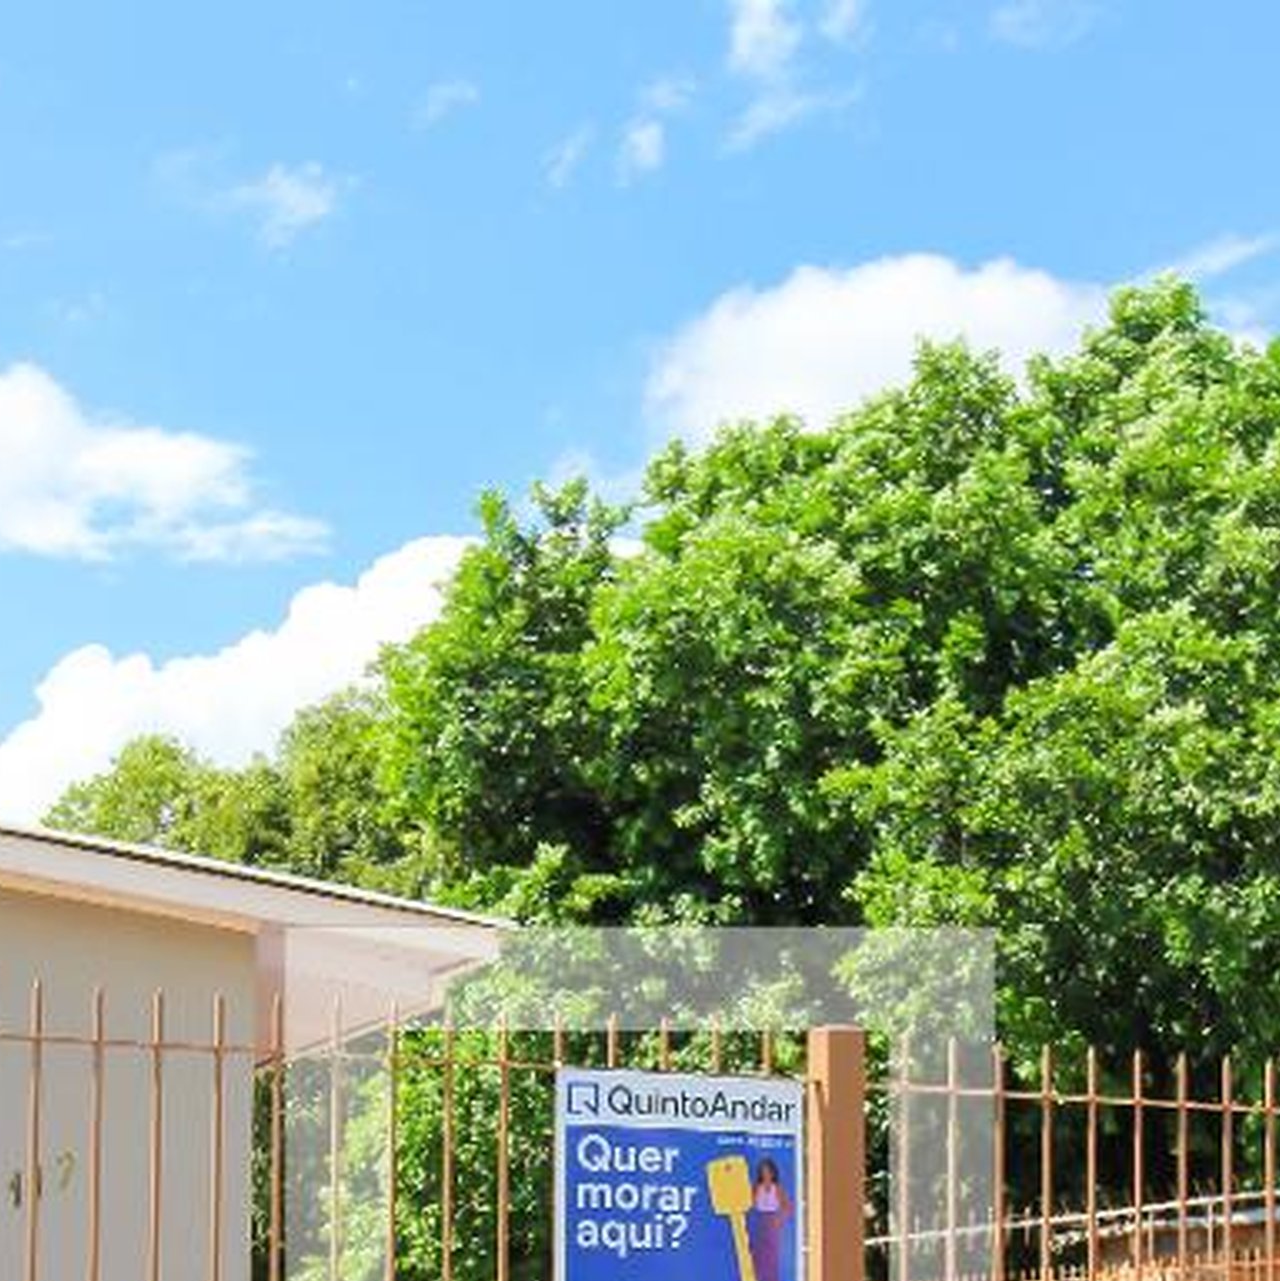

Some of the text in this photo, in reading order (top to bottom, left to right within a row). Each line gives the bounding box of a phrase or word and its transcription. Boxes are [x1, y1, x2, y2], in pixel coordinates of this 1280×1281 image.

[608, 1084, 796, 1122] QuintoAndar
[577, 1134, 680, 1173] Quer
[576, 1182, 697, 1212] morar
[577, 1214, 688, 1258] aqui?
